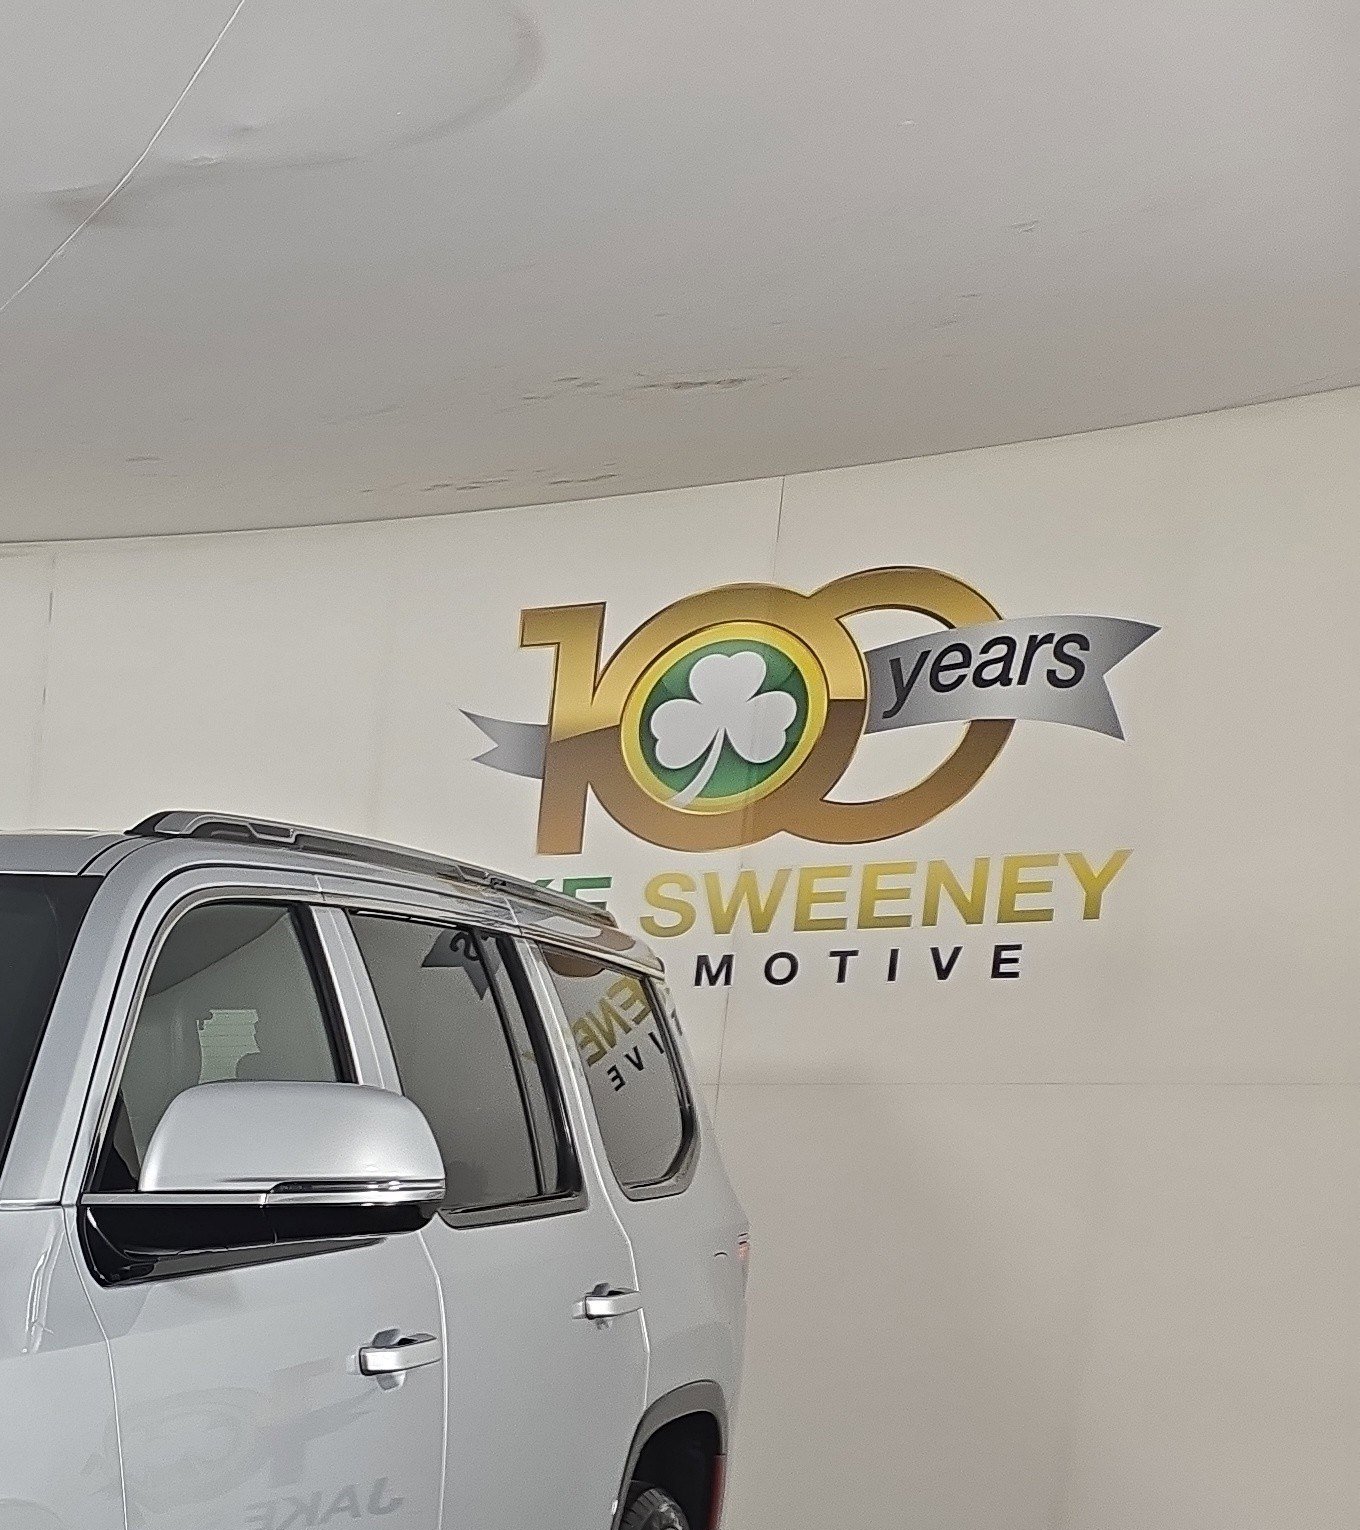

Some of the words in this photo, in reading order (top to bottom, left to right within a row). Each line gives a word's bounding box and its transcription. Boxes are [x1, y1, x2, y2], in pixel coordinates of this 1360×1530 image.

[882, 631, 1091, 720] years
[638, 849, 1134, 939] SWEENEY
[693, 943, 1024, 988] MOTIVE
